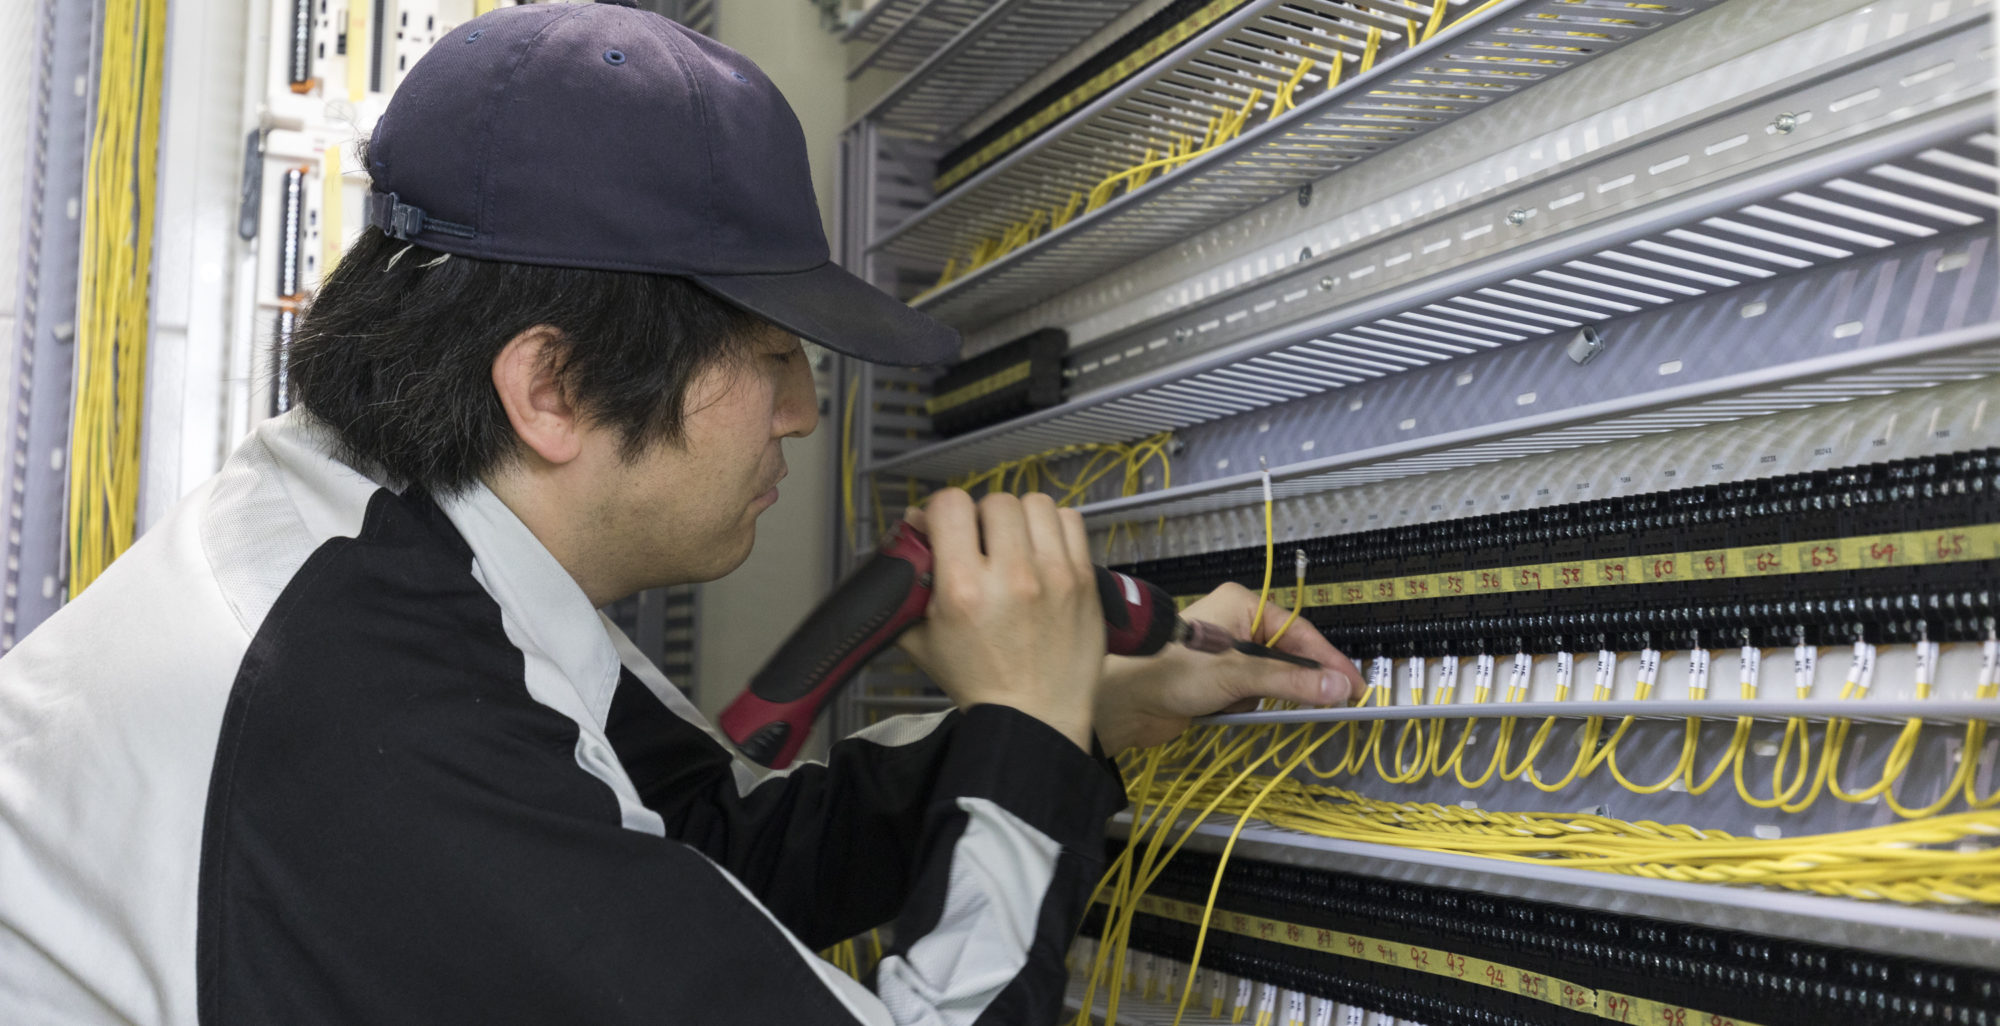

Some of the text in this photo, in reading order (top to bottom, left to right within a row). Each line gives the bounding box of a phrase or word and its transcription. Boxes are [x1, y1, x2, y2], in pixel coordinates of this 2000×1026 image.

[1317, 588, 1329, 603] 51
[1345, 587, 1365, 603] 52
[1379, 582, 1394, 599] 53
[1410, 581, 1428, 595] 54
[1448, 576, 1462, 594] 55
[1482, 573, 1500, 588] 56
[1520, 569, 1542, 590] 57
[1562, 568, 1581, 585] 58
[1605, 564, 1624, 581] 59
[1654, 560, 1673, 578] 60
[1704, 554, 1725, 574] 61
[1757, 552, 1780, 571] 62
[1811, 546, 1838, 567] 63
[1870, 542, 1897, 563] 64
[1937, 536, 1964, 559] 65
[1348, 935, 1365, 953] 90
[1378, 944, 1392, 958] 91
[1410, 947, 1431, 968] 92
[1446, 952, 1465, 977] 93
[1486, 965, 1504, 985] 94
[1522, 974, 1540, 995] 95
[1564, 984, 1585, 1006] 96
[1608, 997, 1629, 1024] 97
[1663, 1008, 1685, 1026] 98
